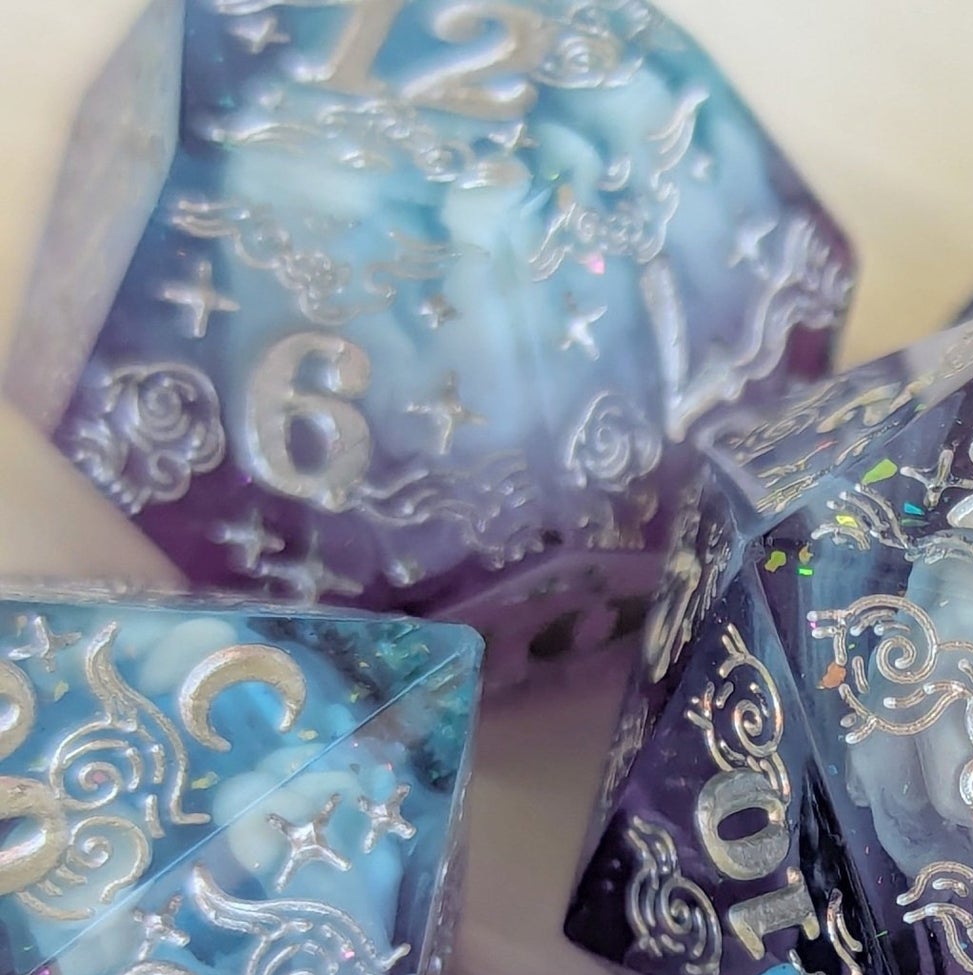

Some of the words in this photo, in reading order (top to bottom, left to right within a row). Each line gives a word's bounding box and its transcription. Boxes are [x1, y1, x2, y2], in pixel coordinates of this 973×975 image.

[293, 0, 553, 122] 12
[246, 332, 373, 513] 6
[697, 767, 820, 960] 10
